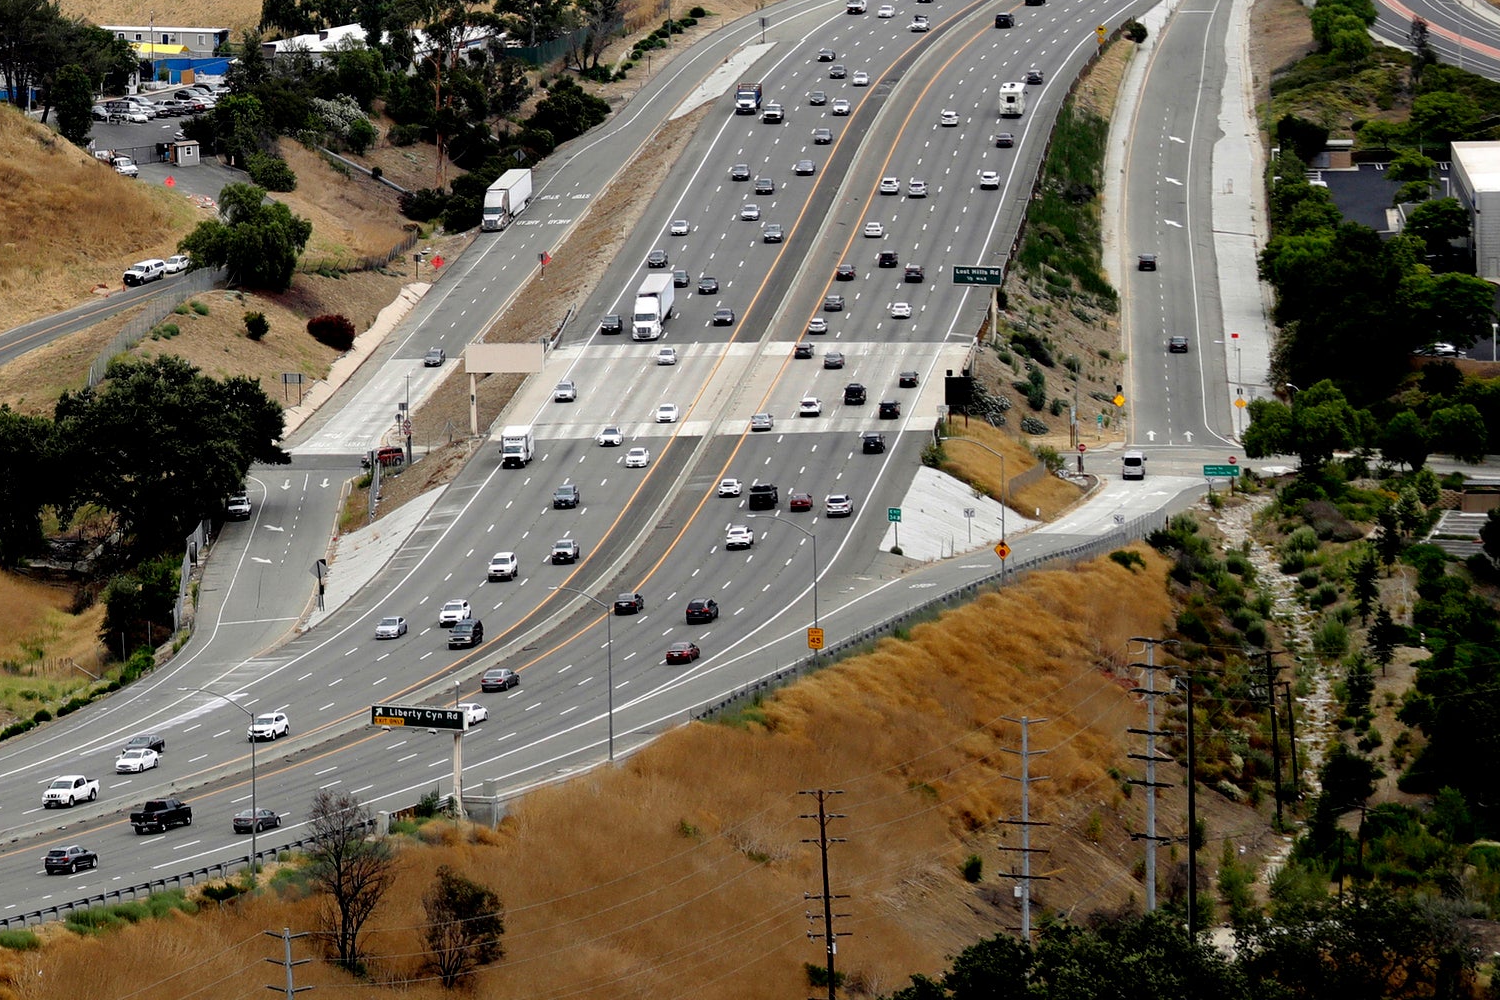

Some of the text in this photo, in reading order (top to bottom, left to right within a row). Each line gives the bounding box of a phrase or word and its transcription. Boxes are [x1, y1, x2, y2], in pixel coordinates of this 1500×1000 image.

[389, 708, 458, 721] Liberty Cyn Rd
